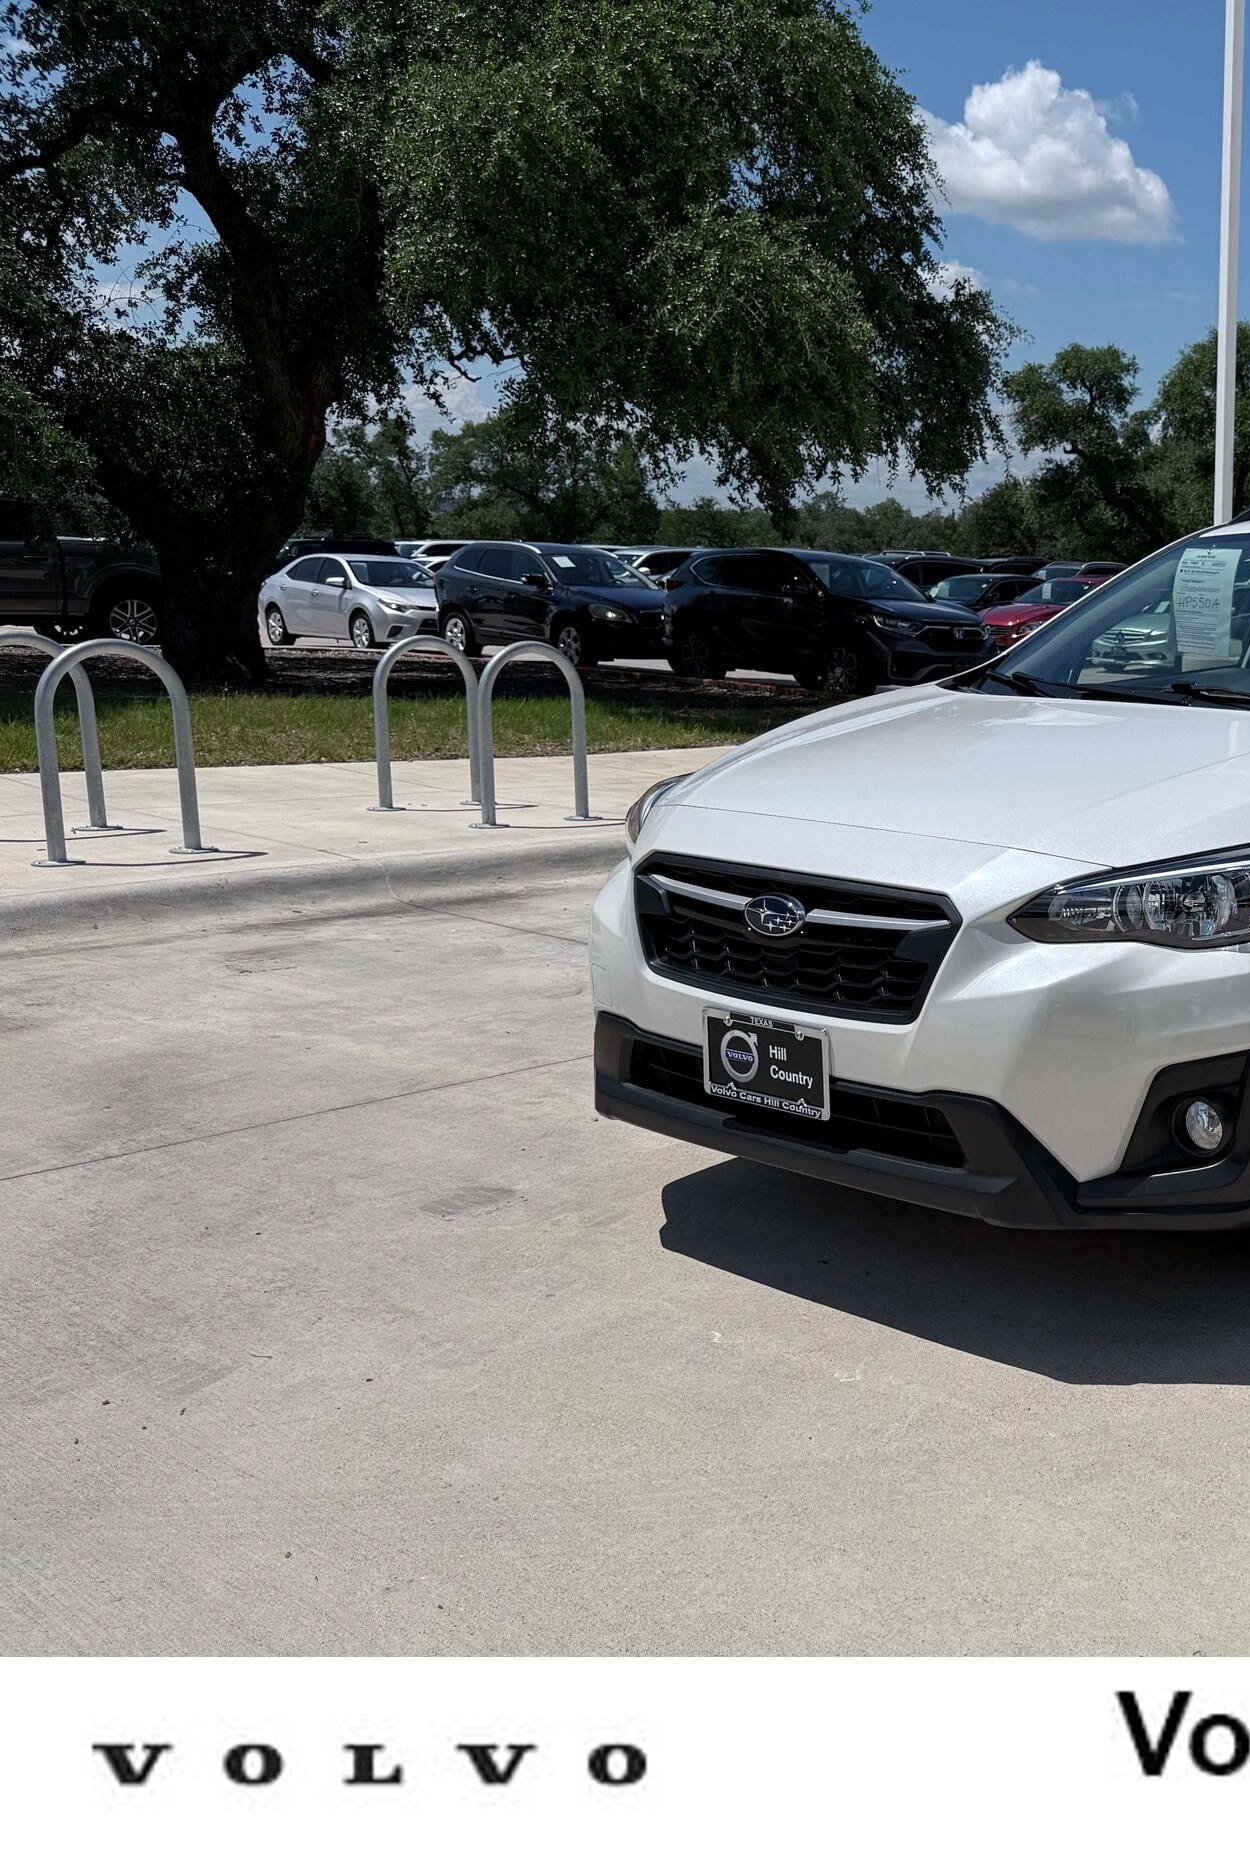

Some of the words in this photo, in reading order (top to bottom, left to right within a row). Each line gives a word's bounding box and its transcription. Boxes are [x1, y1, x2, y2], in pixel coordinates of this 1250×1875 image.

[750, 1017, 773, 1028] TEXAS
[727, 1051, 753, 1062] VOLVO
[769, 1045, 787, 1061] Hill
[770, 1065, 813, 1089] Country
[711, 1085, 738, 1098] Volvo
[740, 1091, 762, 1103] Cars
[764, 1098, 780, 1108] Hill
[782, 1101, 821, 1118] Country
